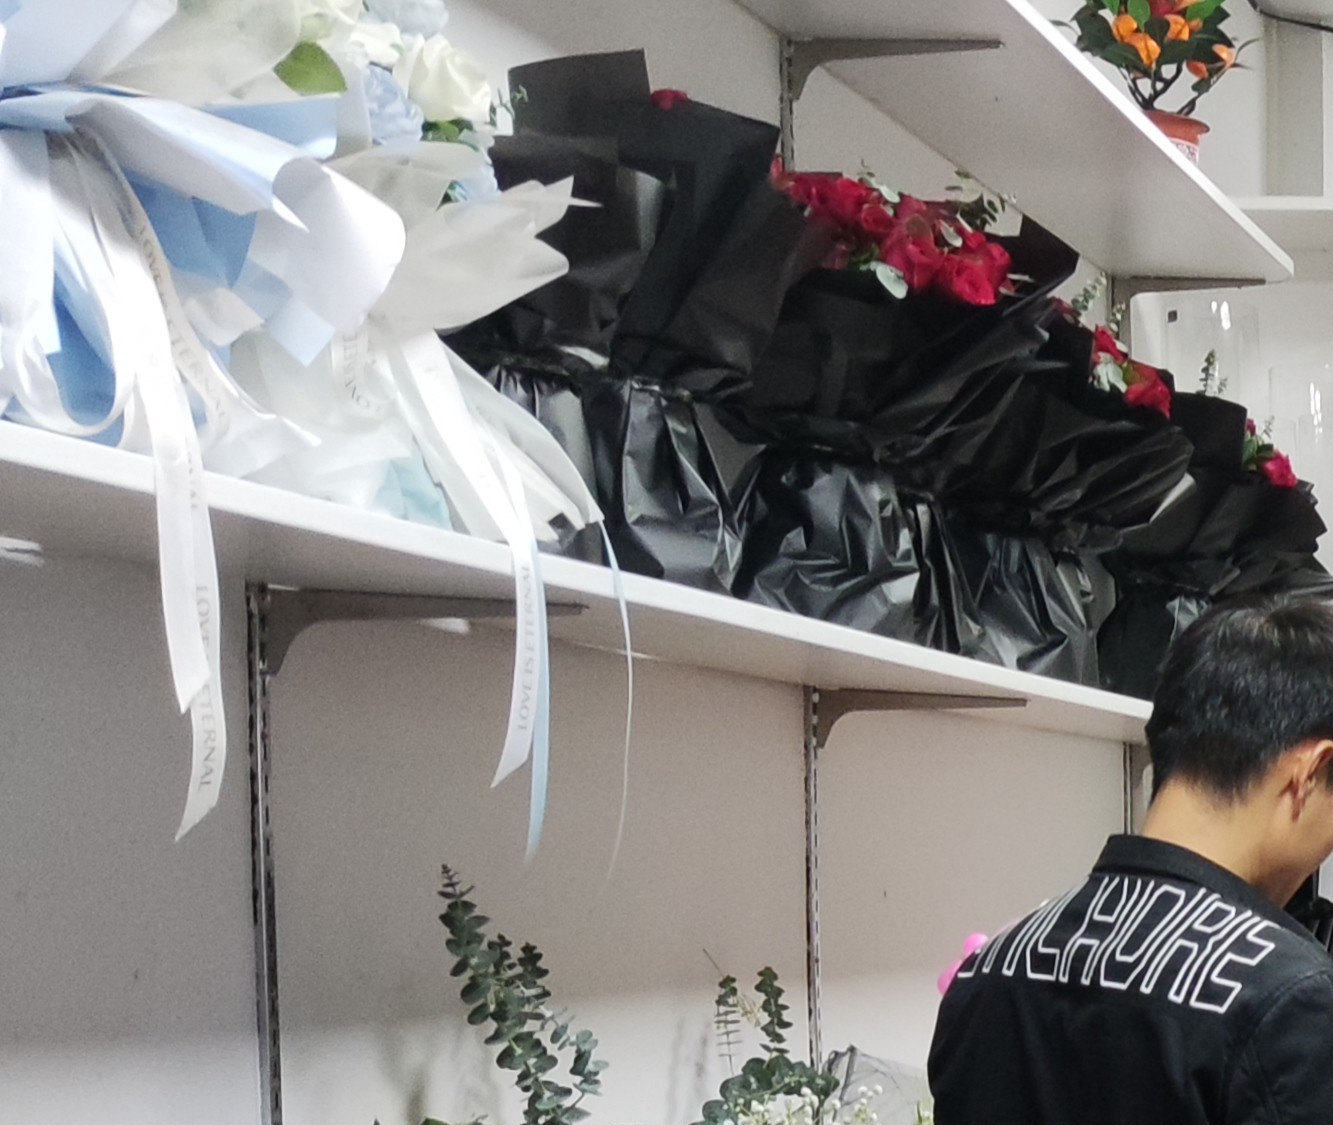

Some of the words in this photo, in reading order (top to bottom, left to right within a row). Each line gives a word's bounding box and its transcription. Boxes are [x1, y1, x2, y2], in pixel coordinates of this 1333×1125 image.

[524, 658, 535, 674] IS
[517, 683, 532, 731] LOVE
[198, 682, 217, 791] ETERNAL
